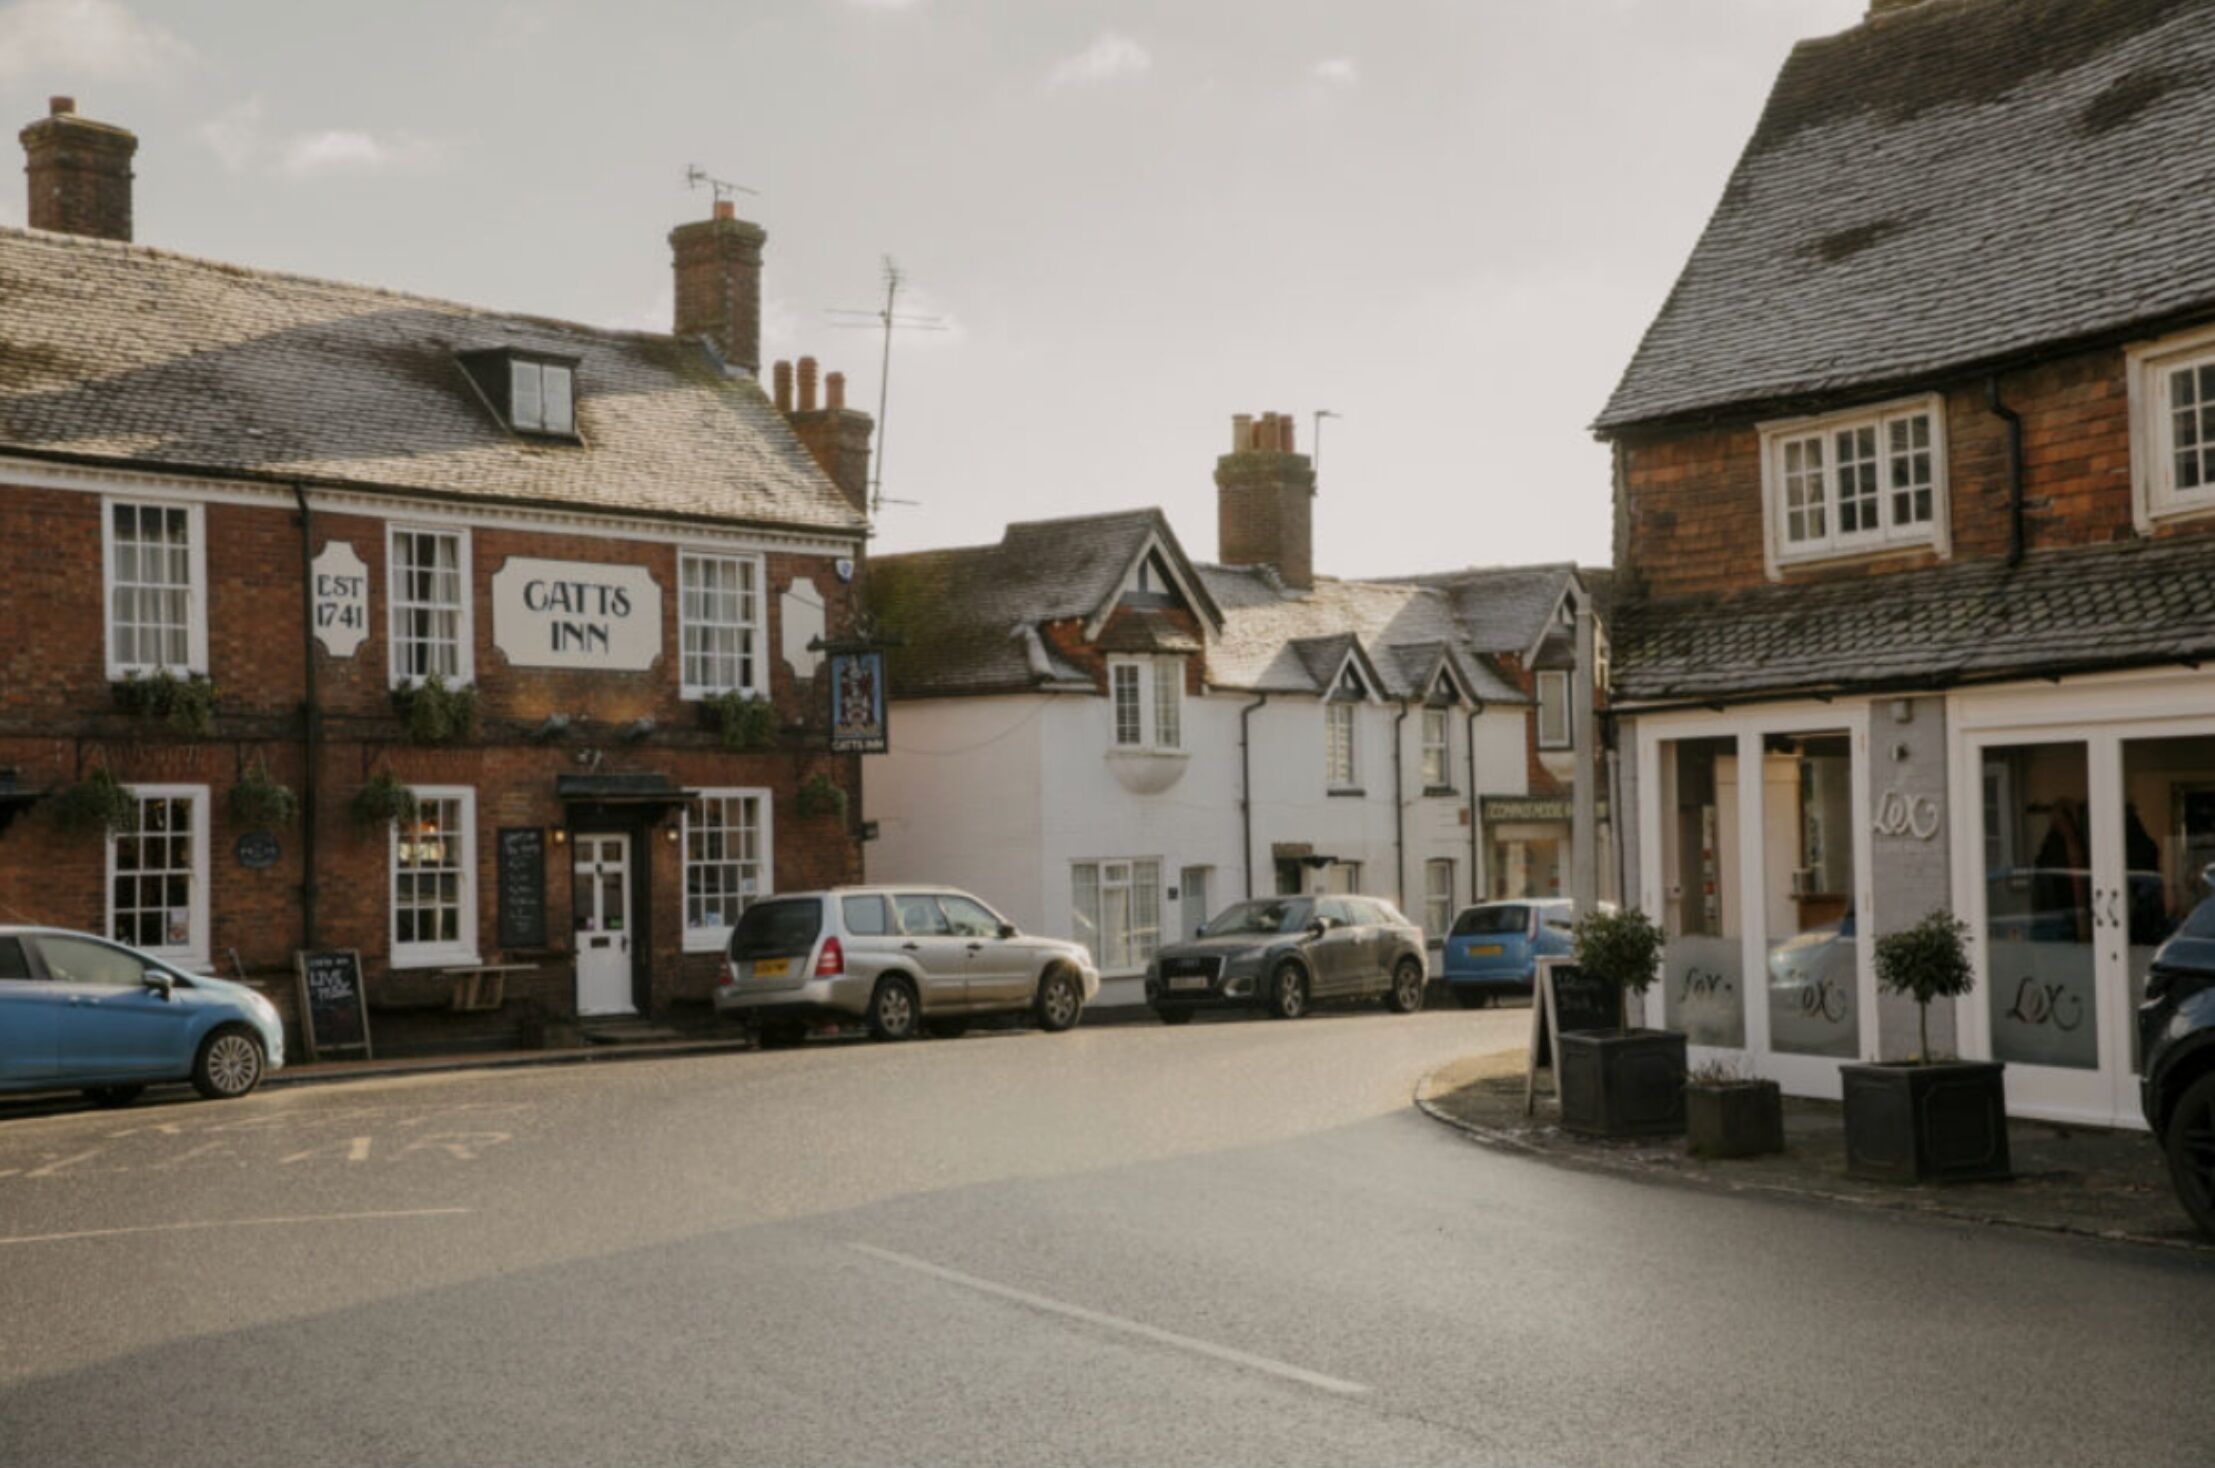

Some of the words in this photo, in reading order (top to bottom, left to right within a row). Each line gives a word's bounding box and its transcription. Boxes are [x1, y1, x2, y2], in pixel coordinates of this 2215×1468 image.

[317, 574, 363, 598] EST
[317, 603, 363, 628] 1741
[550, 621, 610, 653] INN
